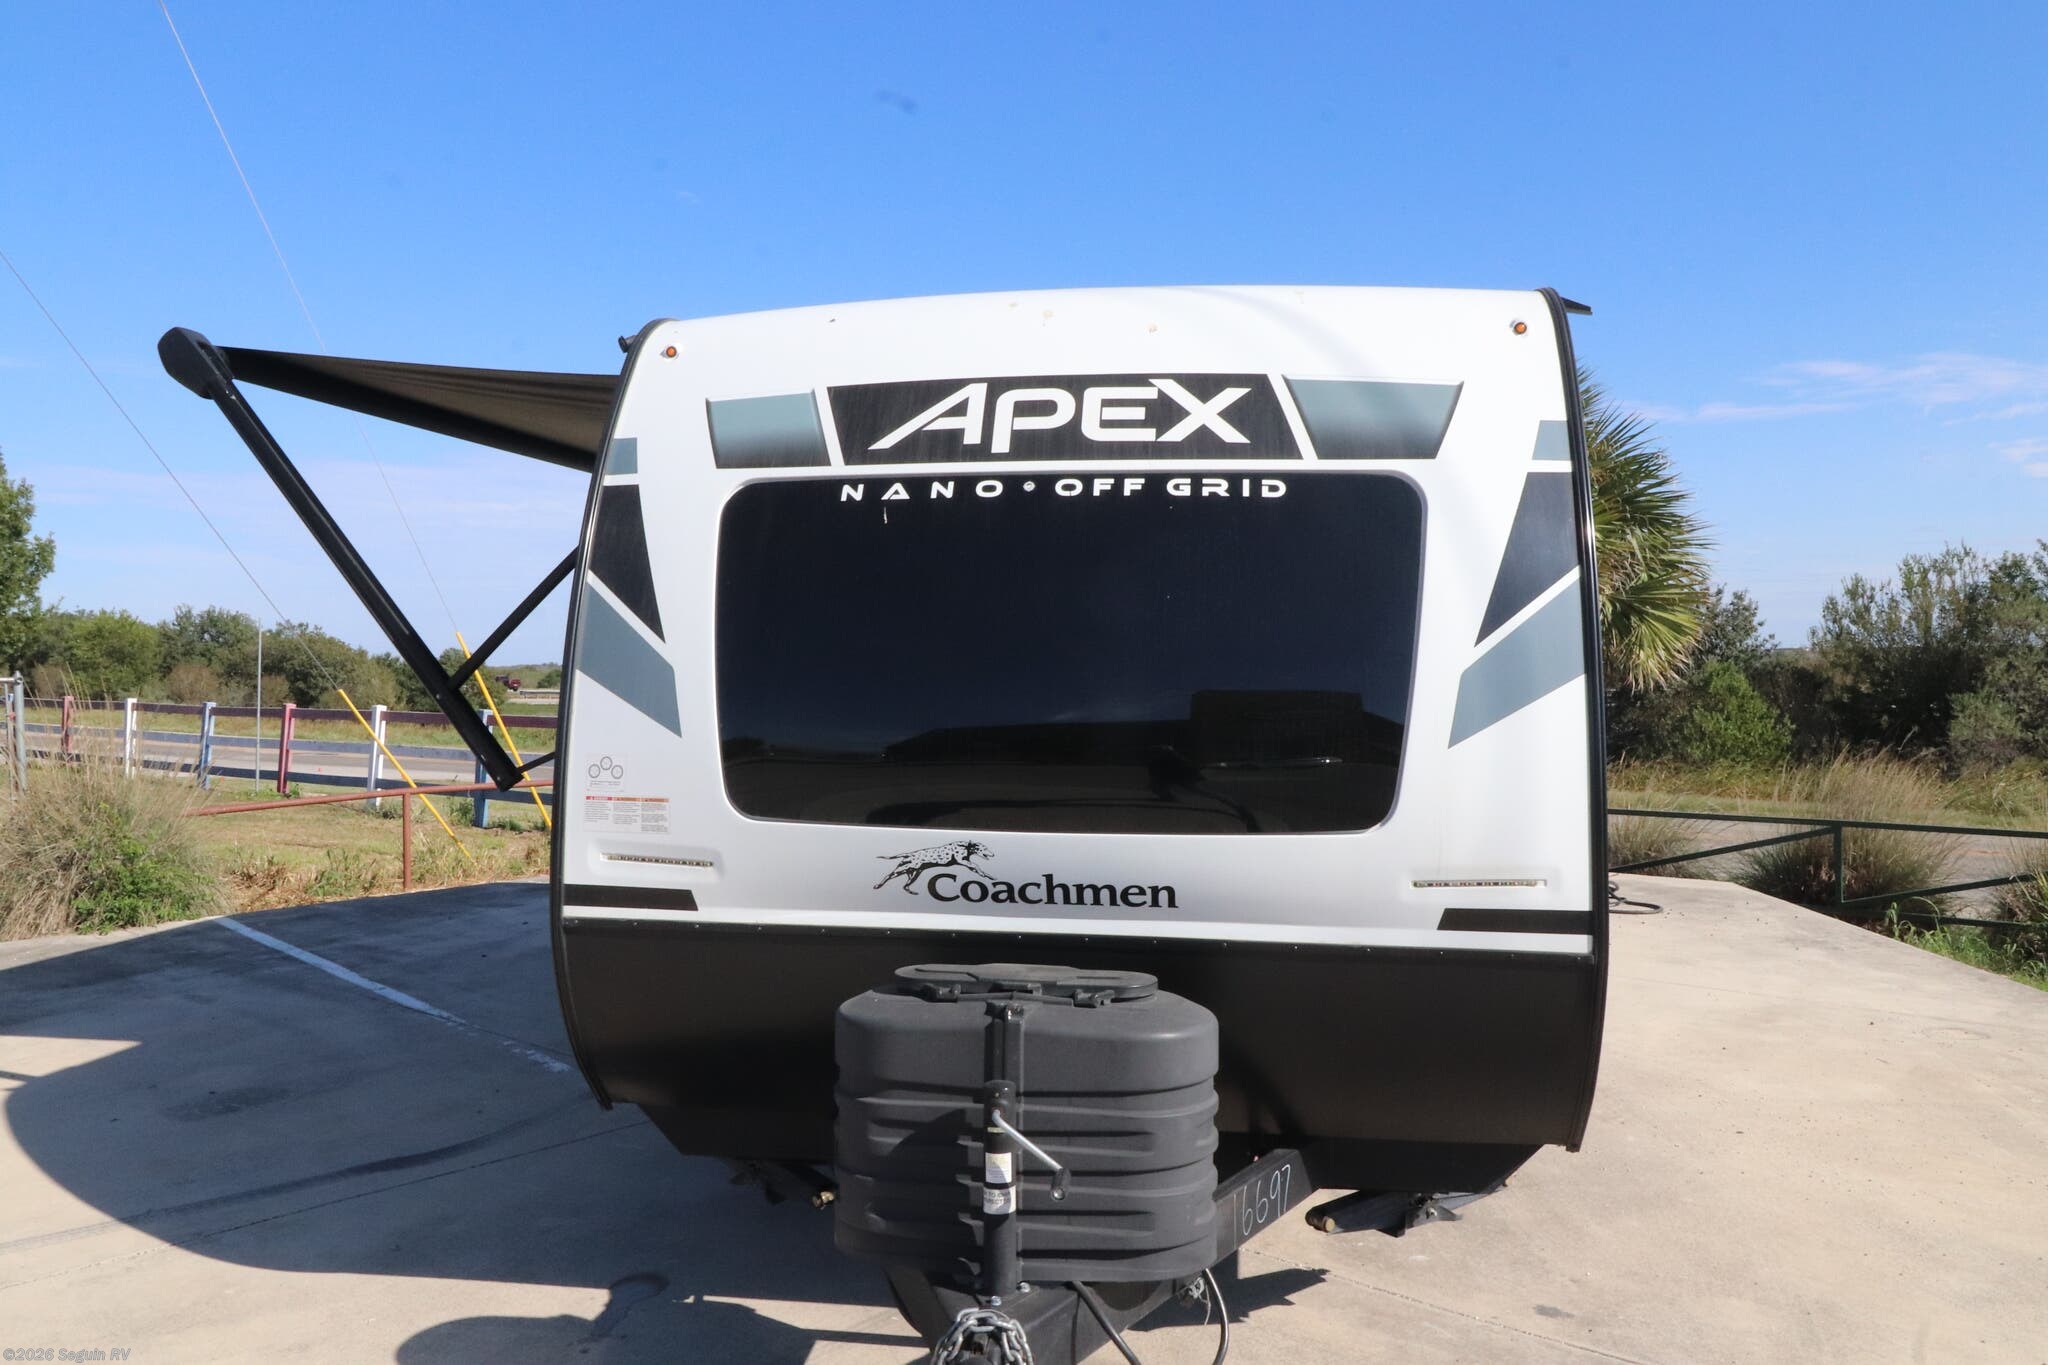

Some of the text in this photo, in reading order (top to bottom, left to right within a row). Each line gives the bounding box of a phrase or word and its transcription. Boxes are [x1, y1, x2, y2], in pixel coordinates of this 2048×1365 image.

[867, 378, 1252, 454] APEX
[840, 478, 1287, 502] NANO OFF GRID
[927, 873, 1178, 908] Coachmen
[1233, 1163, 1291, 1250] 16697
